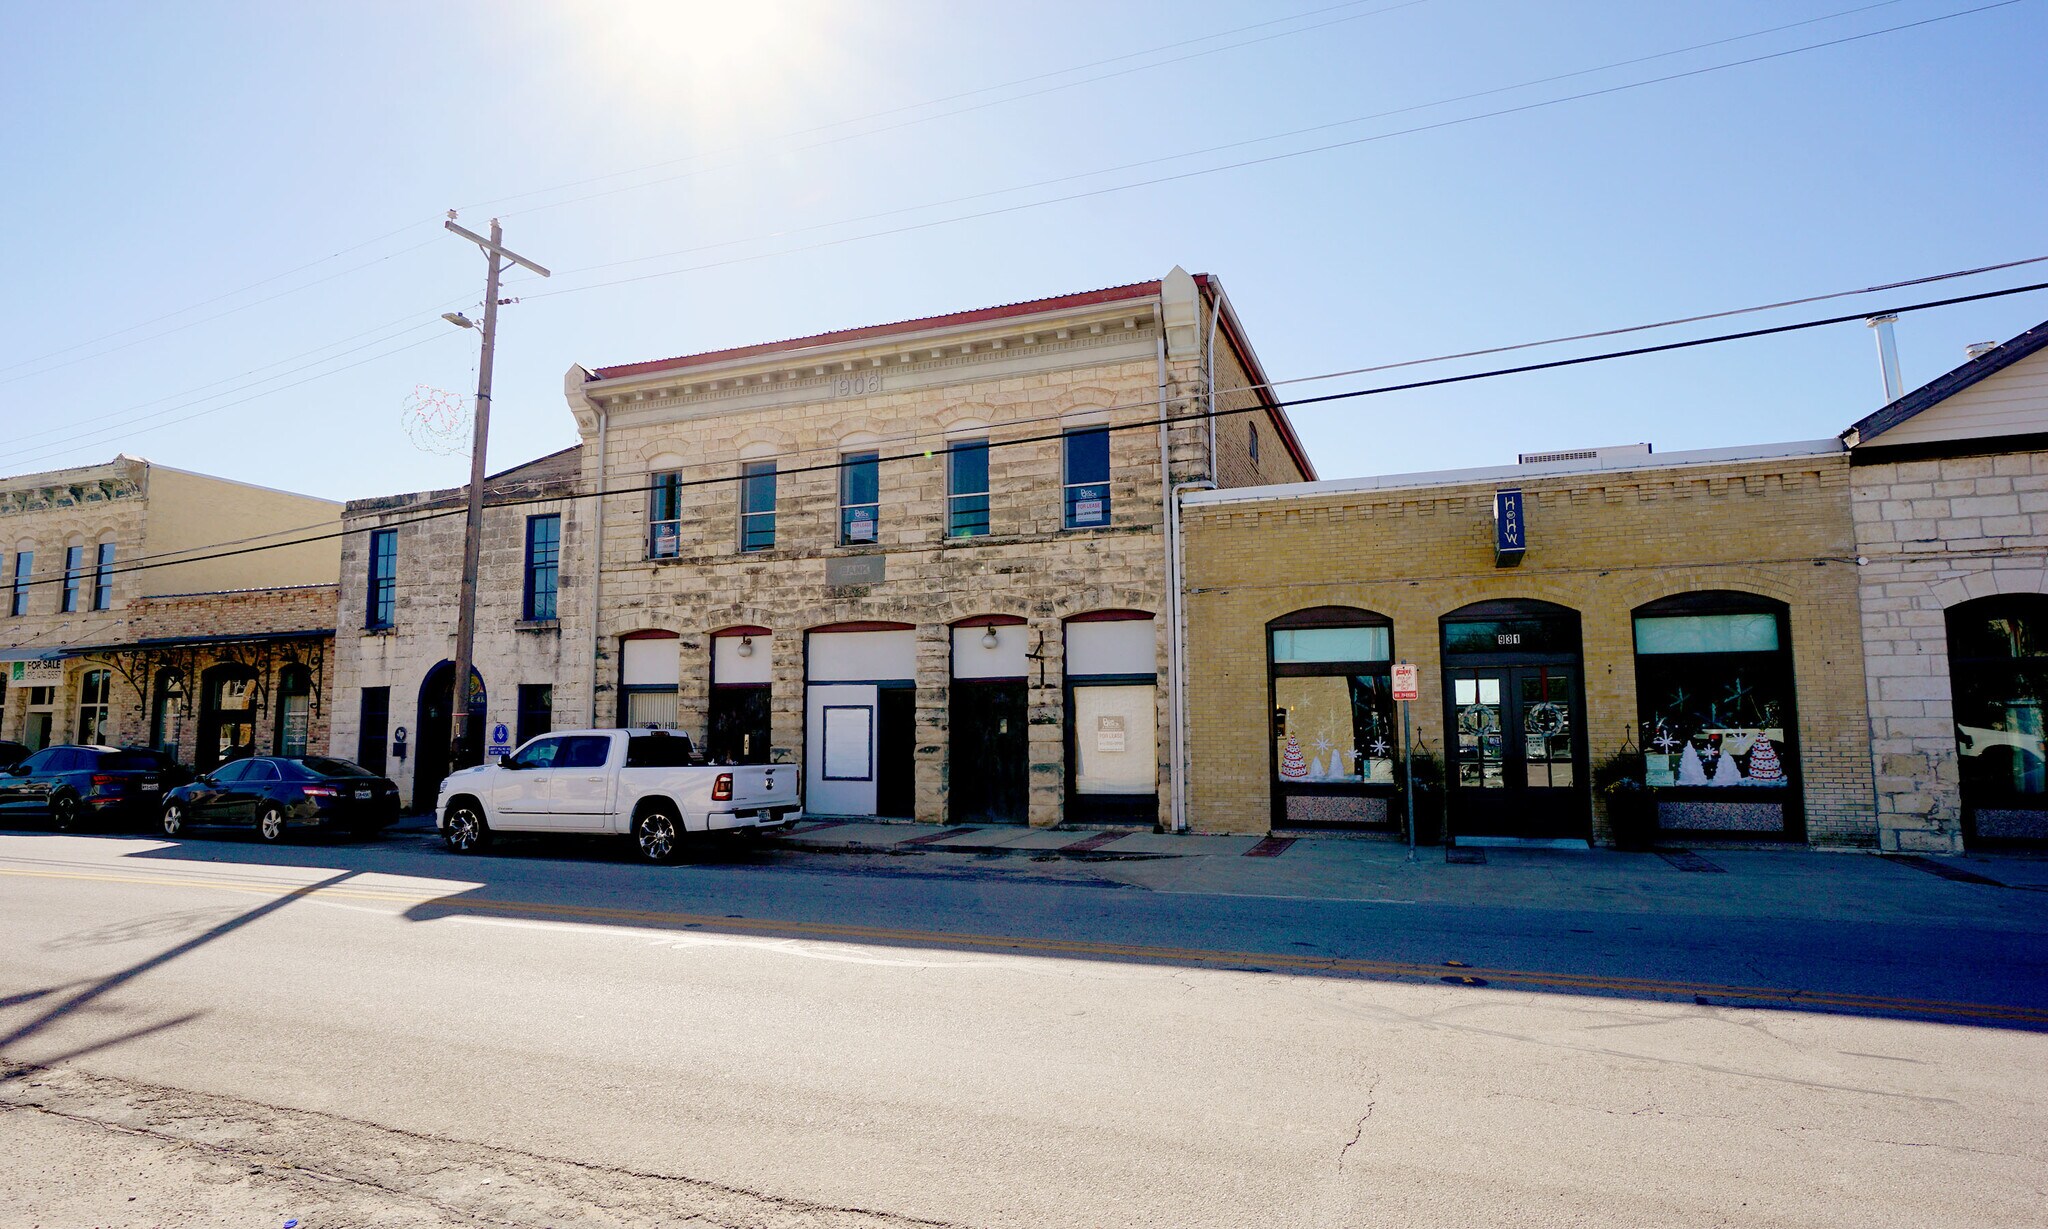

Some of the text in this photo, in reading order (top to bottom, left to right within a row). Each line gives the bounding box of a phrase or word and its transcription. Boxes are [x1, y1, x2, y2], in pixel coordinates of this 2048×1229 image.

[832, 374, 879, 398] 1906
[1498, 634, 1520, 645] 931
[27, 660, 61, 670] FOR SALE
